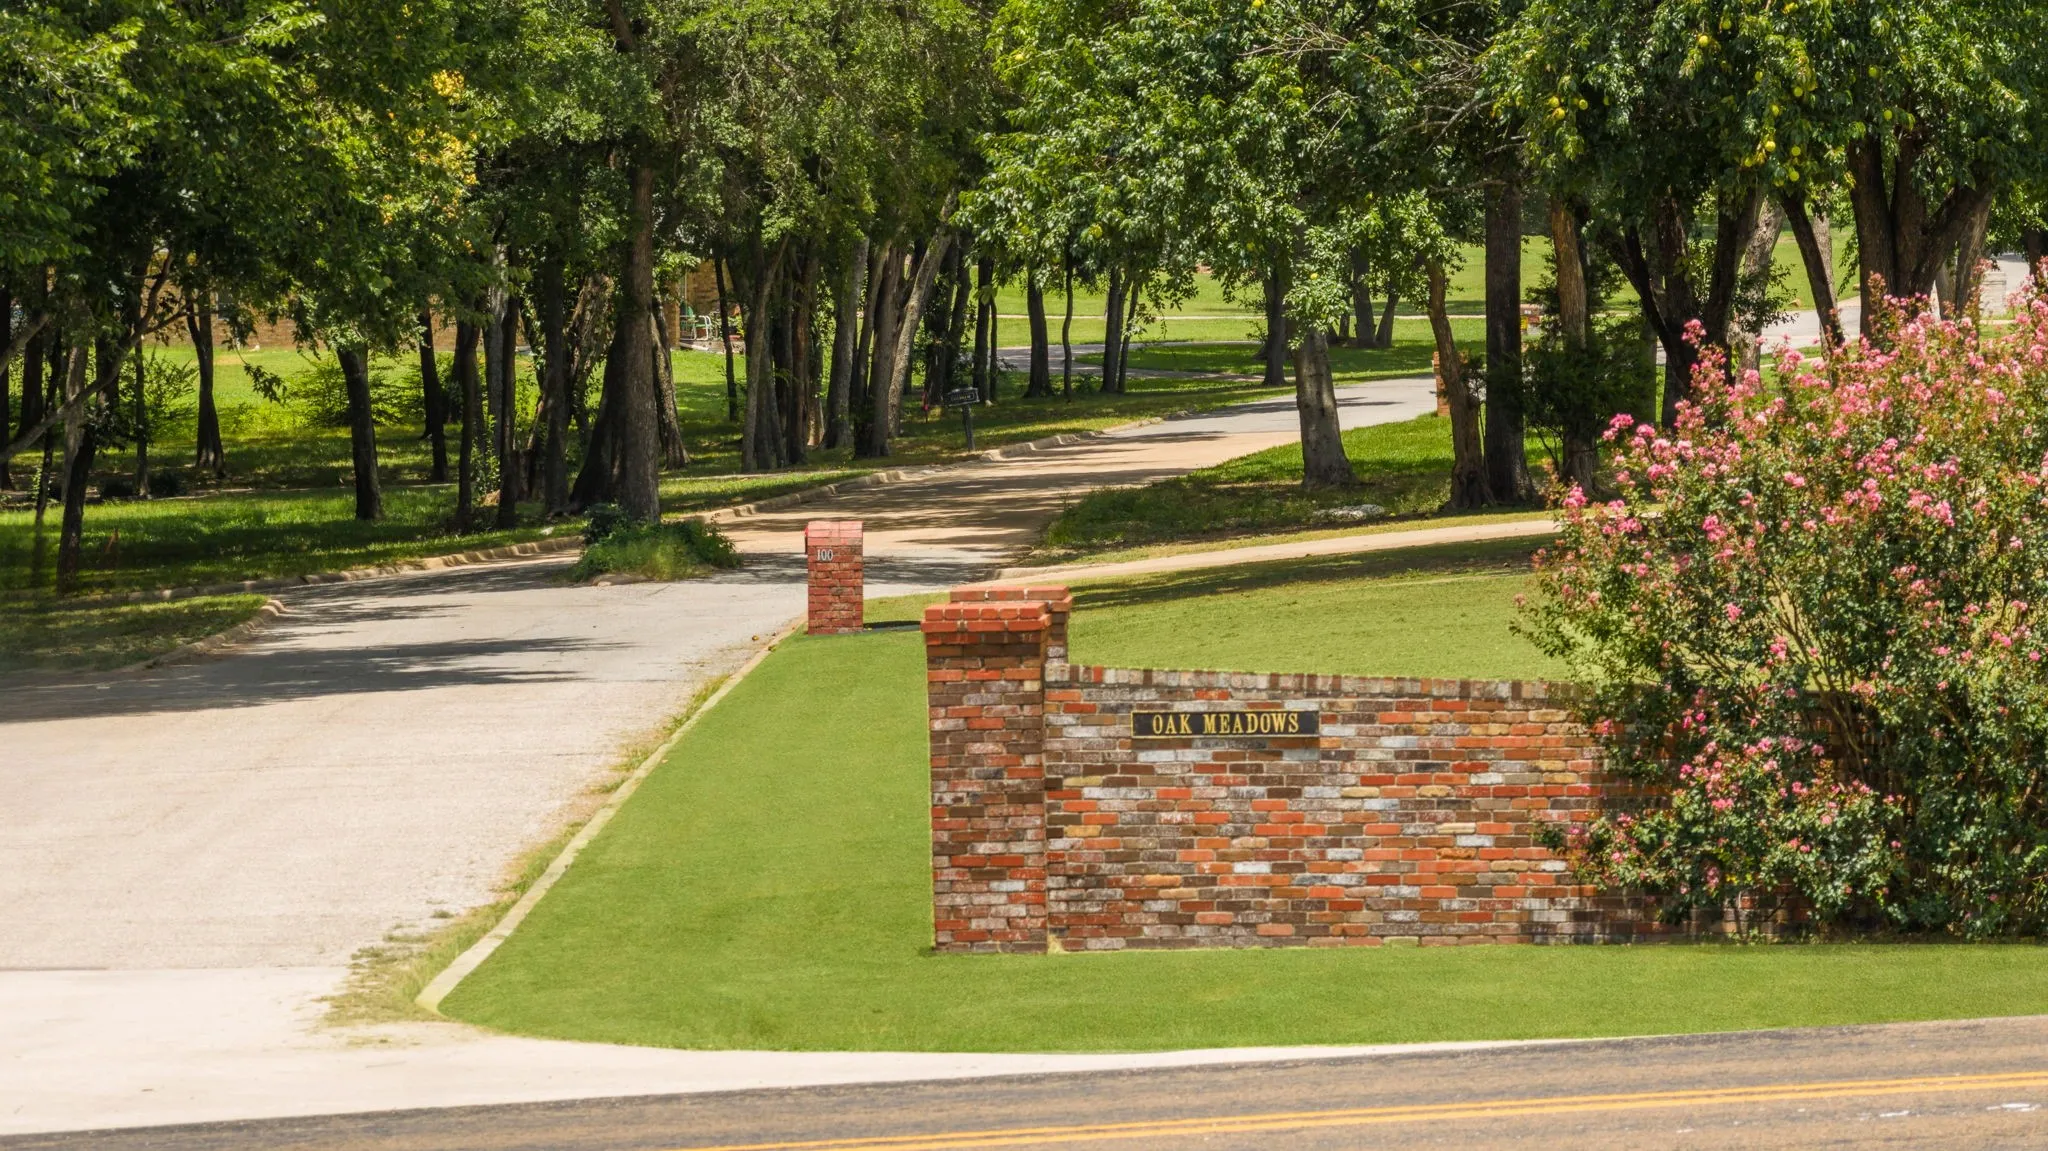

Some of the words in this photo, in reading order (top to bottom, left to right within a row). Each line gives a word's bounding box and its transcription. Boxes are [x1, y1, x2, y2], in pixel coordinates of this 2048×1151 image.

[816, 549, 834, 561] 100
[1152, 713, 1192, 734] OAK
[1202, 712, 1299, 734] MEADOWS
